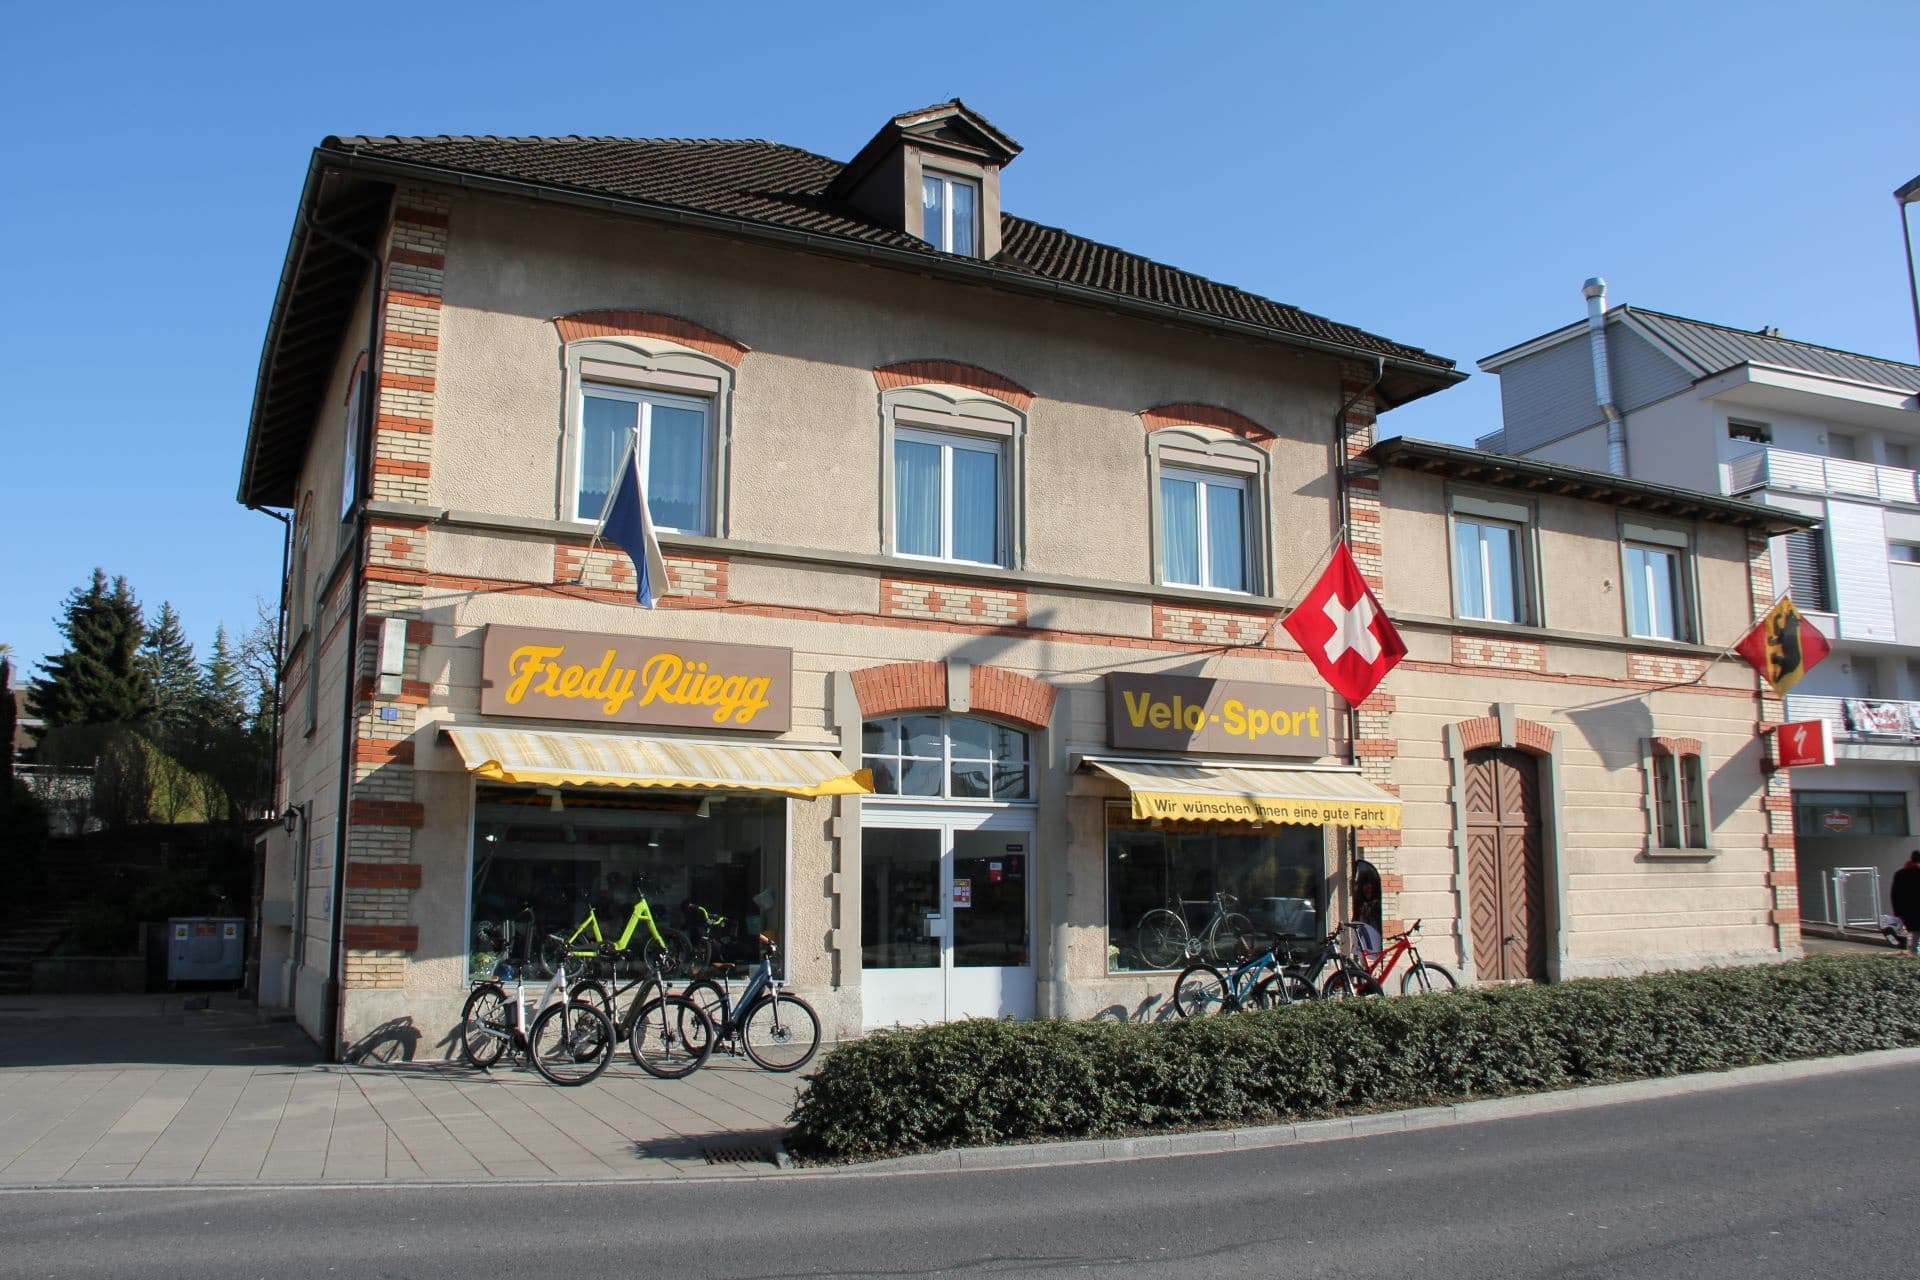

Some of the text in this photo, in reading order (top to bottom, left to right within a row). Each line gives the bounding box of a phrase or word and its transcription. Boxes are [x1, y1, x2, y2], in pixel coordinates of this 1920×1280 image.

[505, 645, 772, 724] Fredy Rüegg
[1123, 691, 1320, 740] Velo-Sport
[1154, 799, 1177, 812] Wir
[1183, 801, 1251, 815] wünschen
[1293, 806, 1318, 819] eine
[1323, 808, 1349, 821] gute
[1354, 808, 1384, 821] Fahrt
